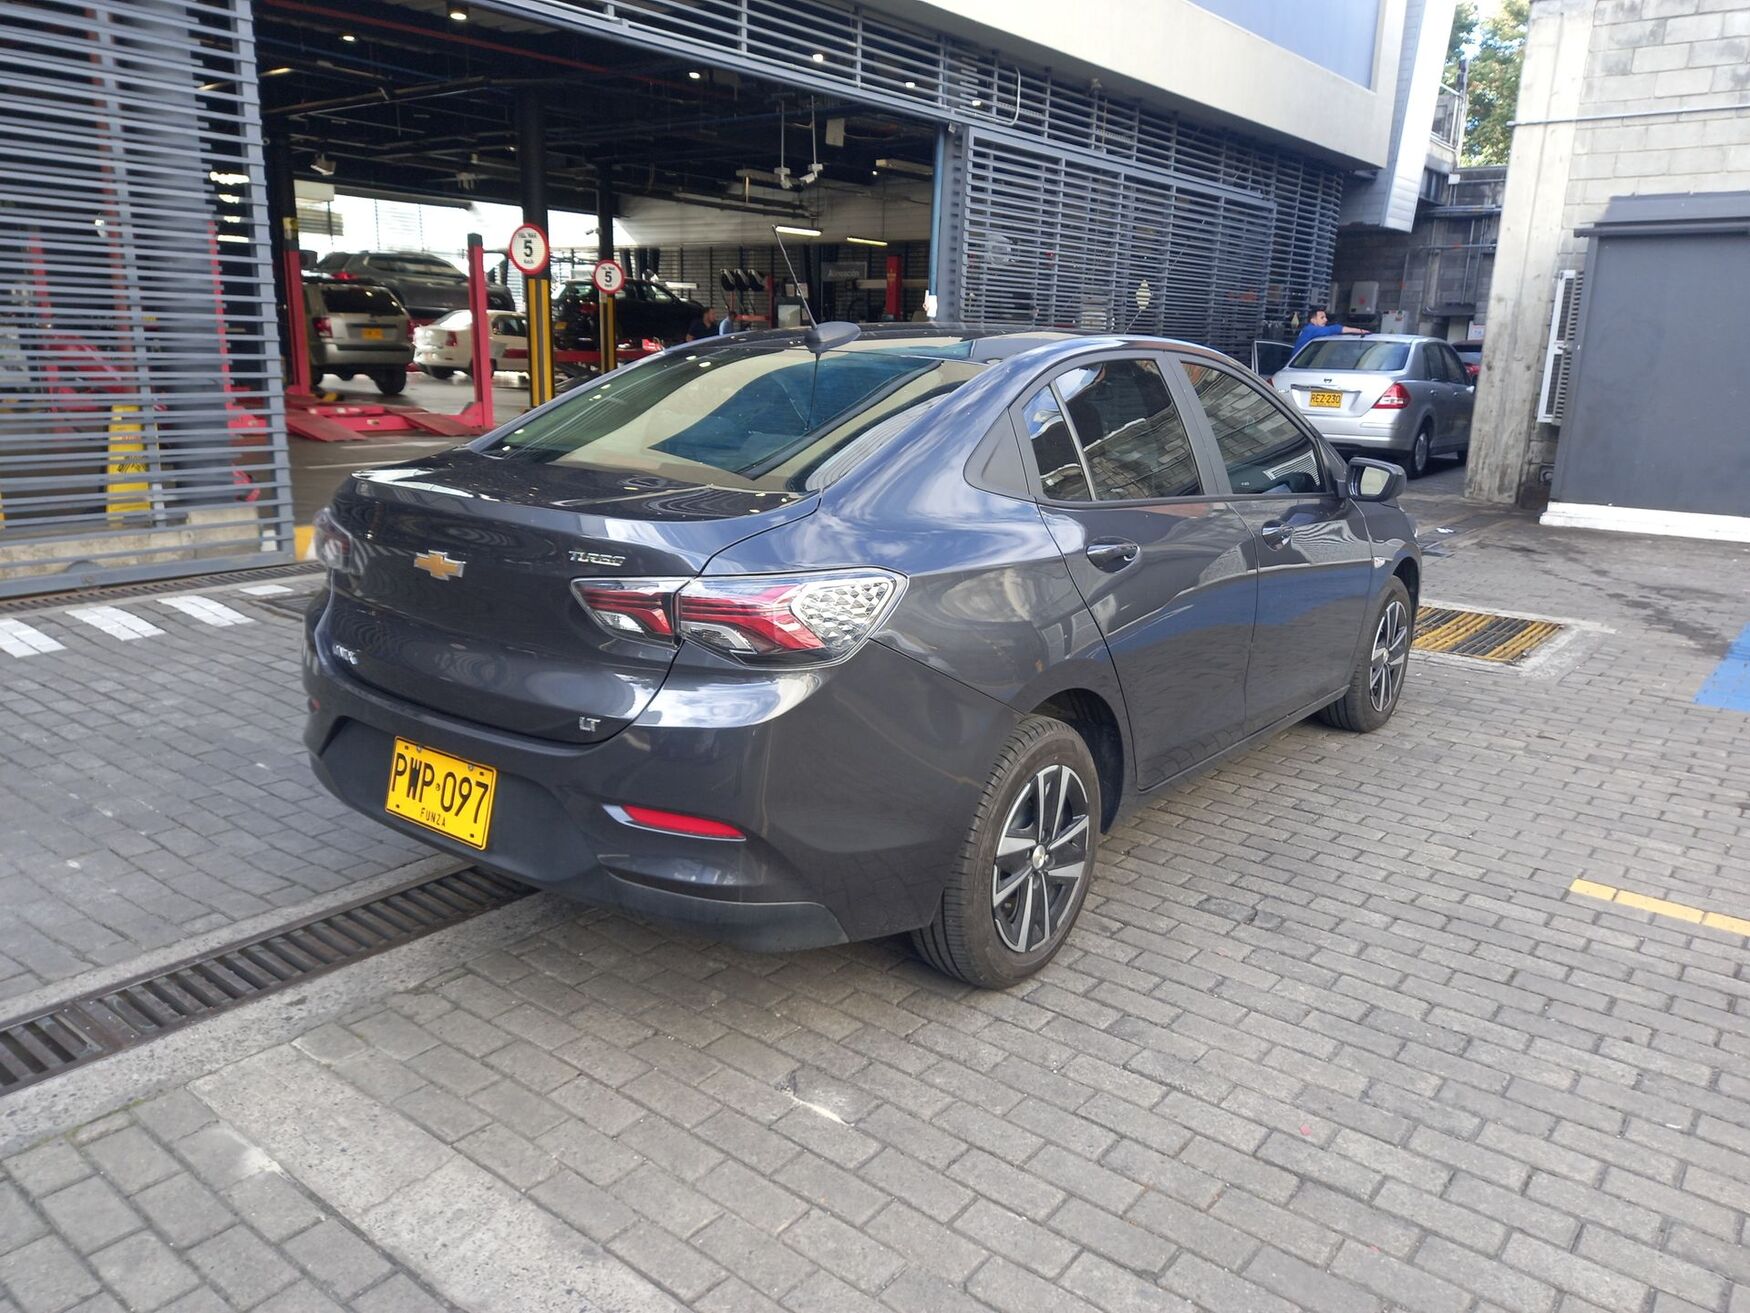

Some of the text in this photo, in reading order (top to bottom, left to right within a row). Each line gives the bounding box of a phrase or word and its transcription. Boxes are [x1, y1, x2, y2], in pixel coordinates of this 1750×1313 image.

[523, 239, 533, 257] 5
[604, 271, 613, 283] 5
[579, 716, 601, 732] LT
[420, 807, 446, 828] FUNZA
